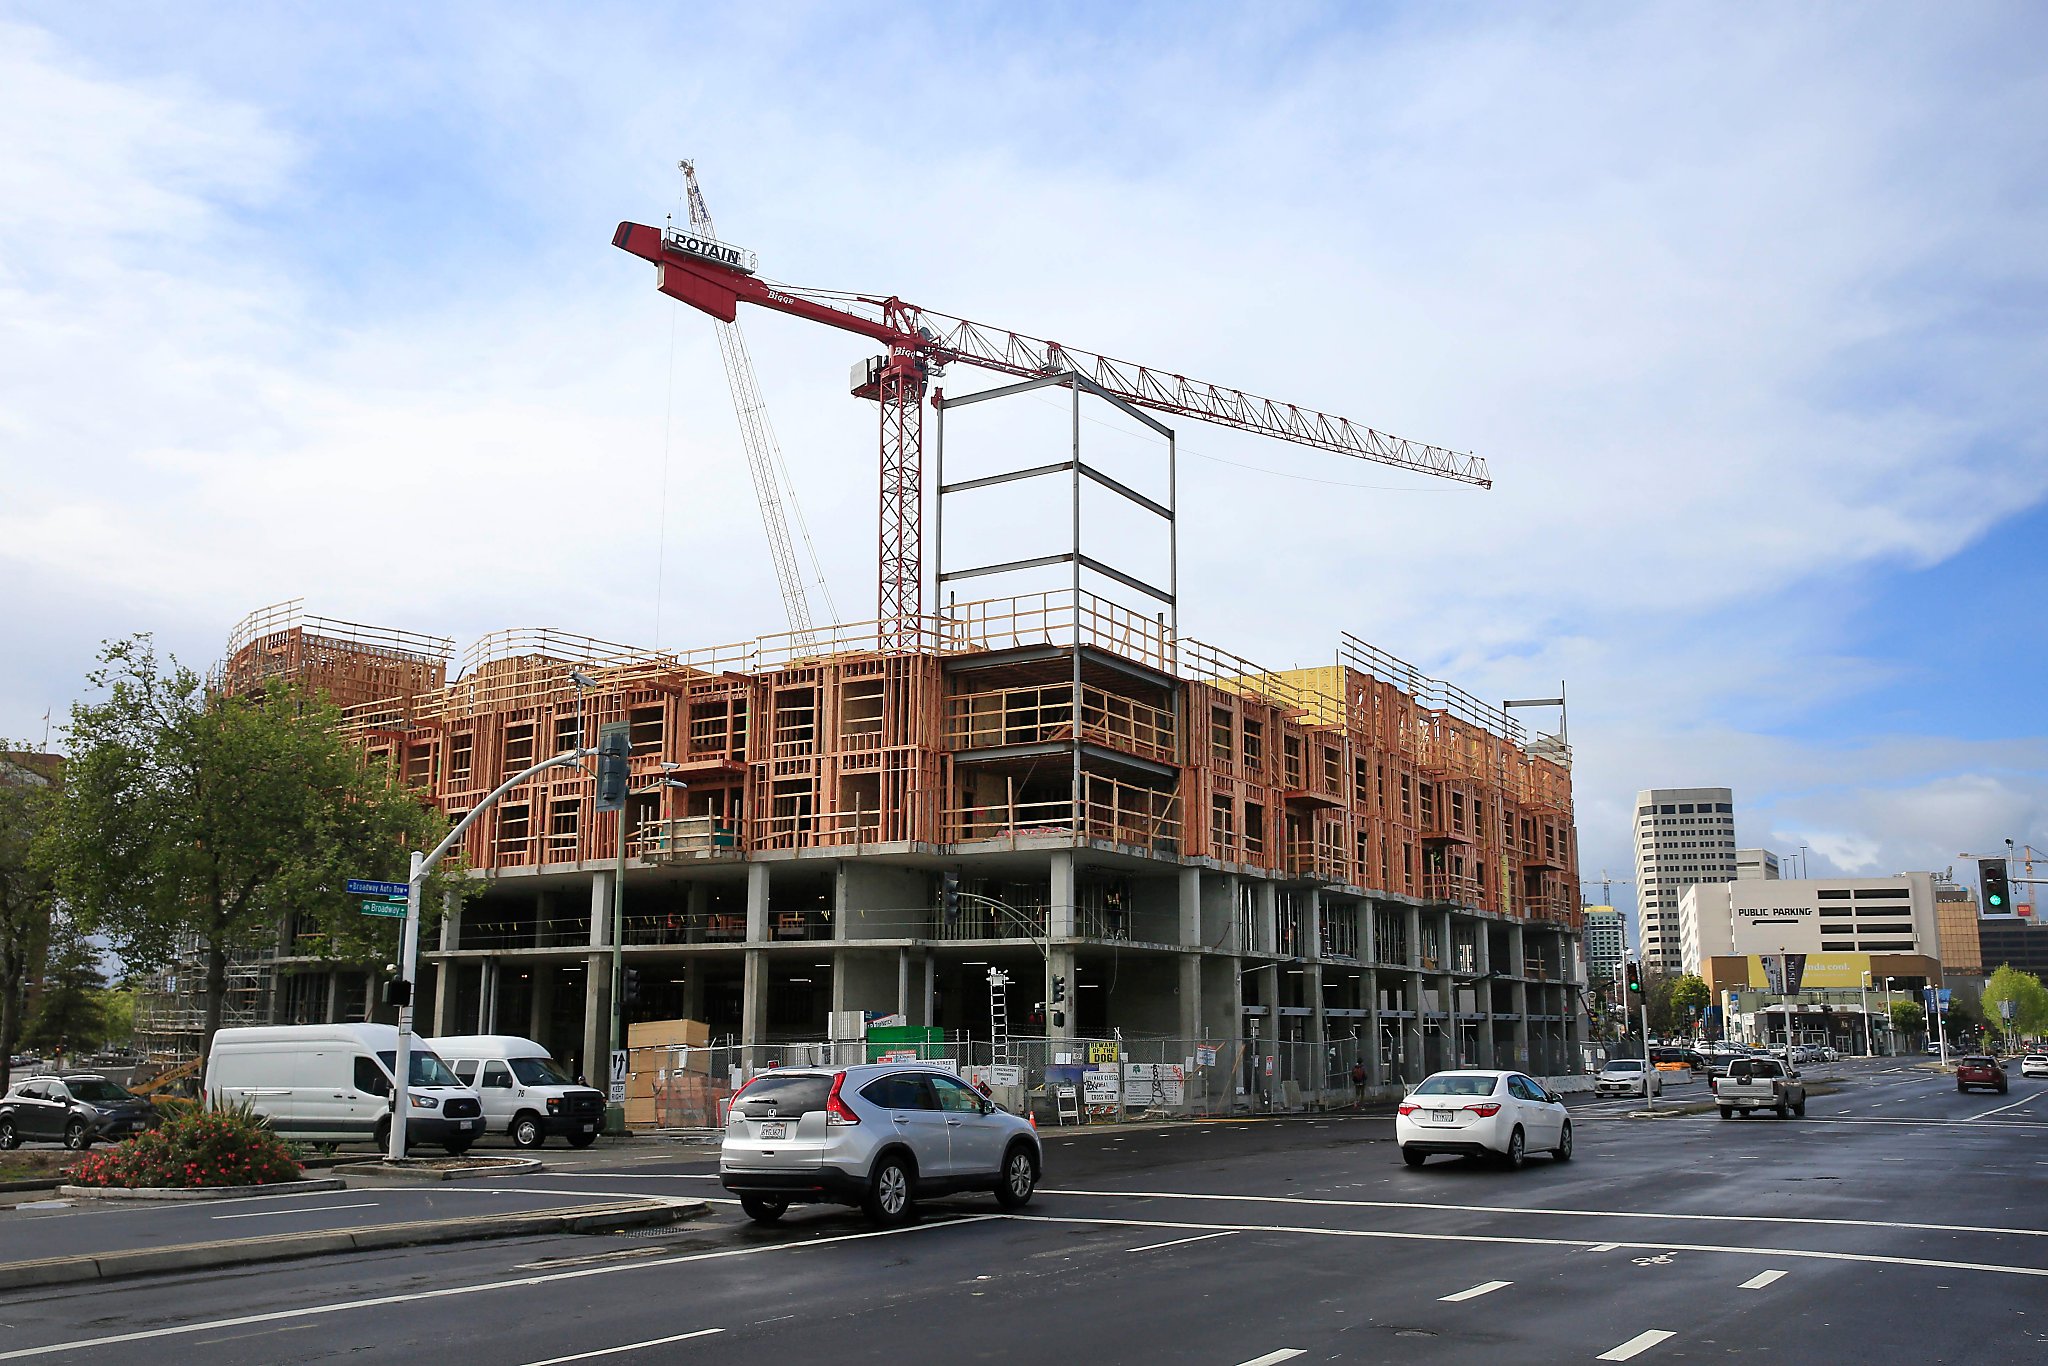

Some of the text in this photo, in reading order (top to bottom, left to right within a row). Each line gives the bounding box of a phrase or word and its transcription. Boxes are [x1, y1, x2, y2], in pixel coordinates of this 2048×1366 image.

[675, 233, 742, 265] POTAIN
[352, 882, 405, 894] Broadway Auto Row
[370, 903, 400, 916] Broadway
[1738, 907, 1813, 917] PUBLIC PARKING
[1787, 961, 1796, 986] MUSIC
[1094, 1053, 1113, 1062] DOG
[517, 1089, 525, 1098] 76
